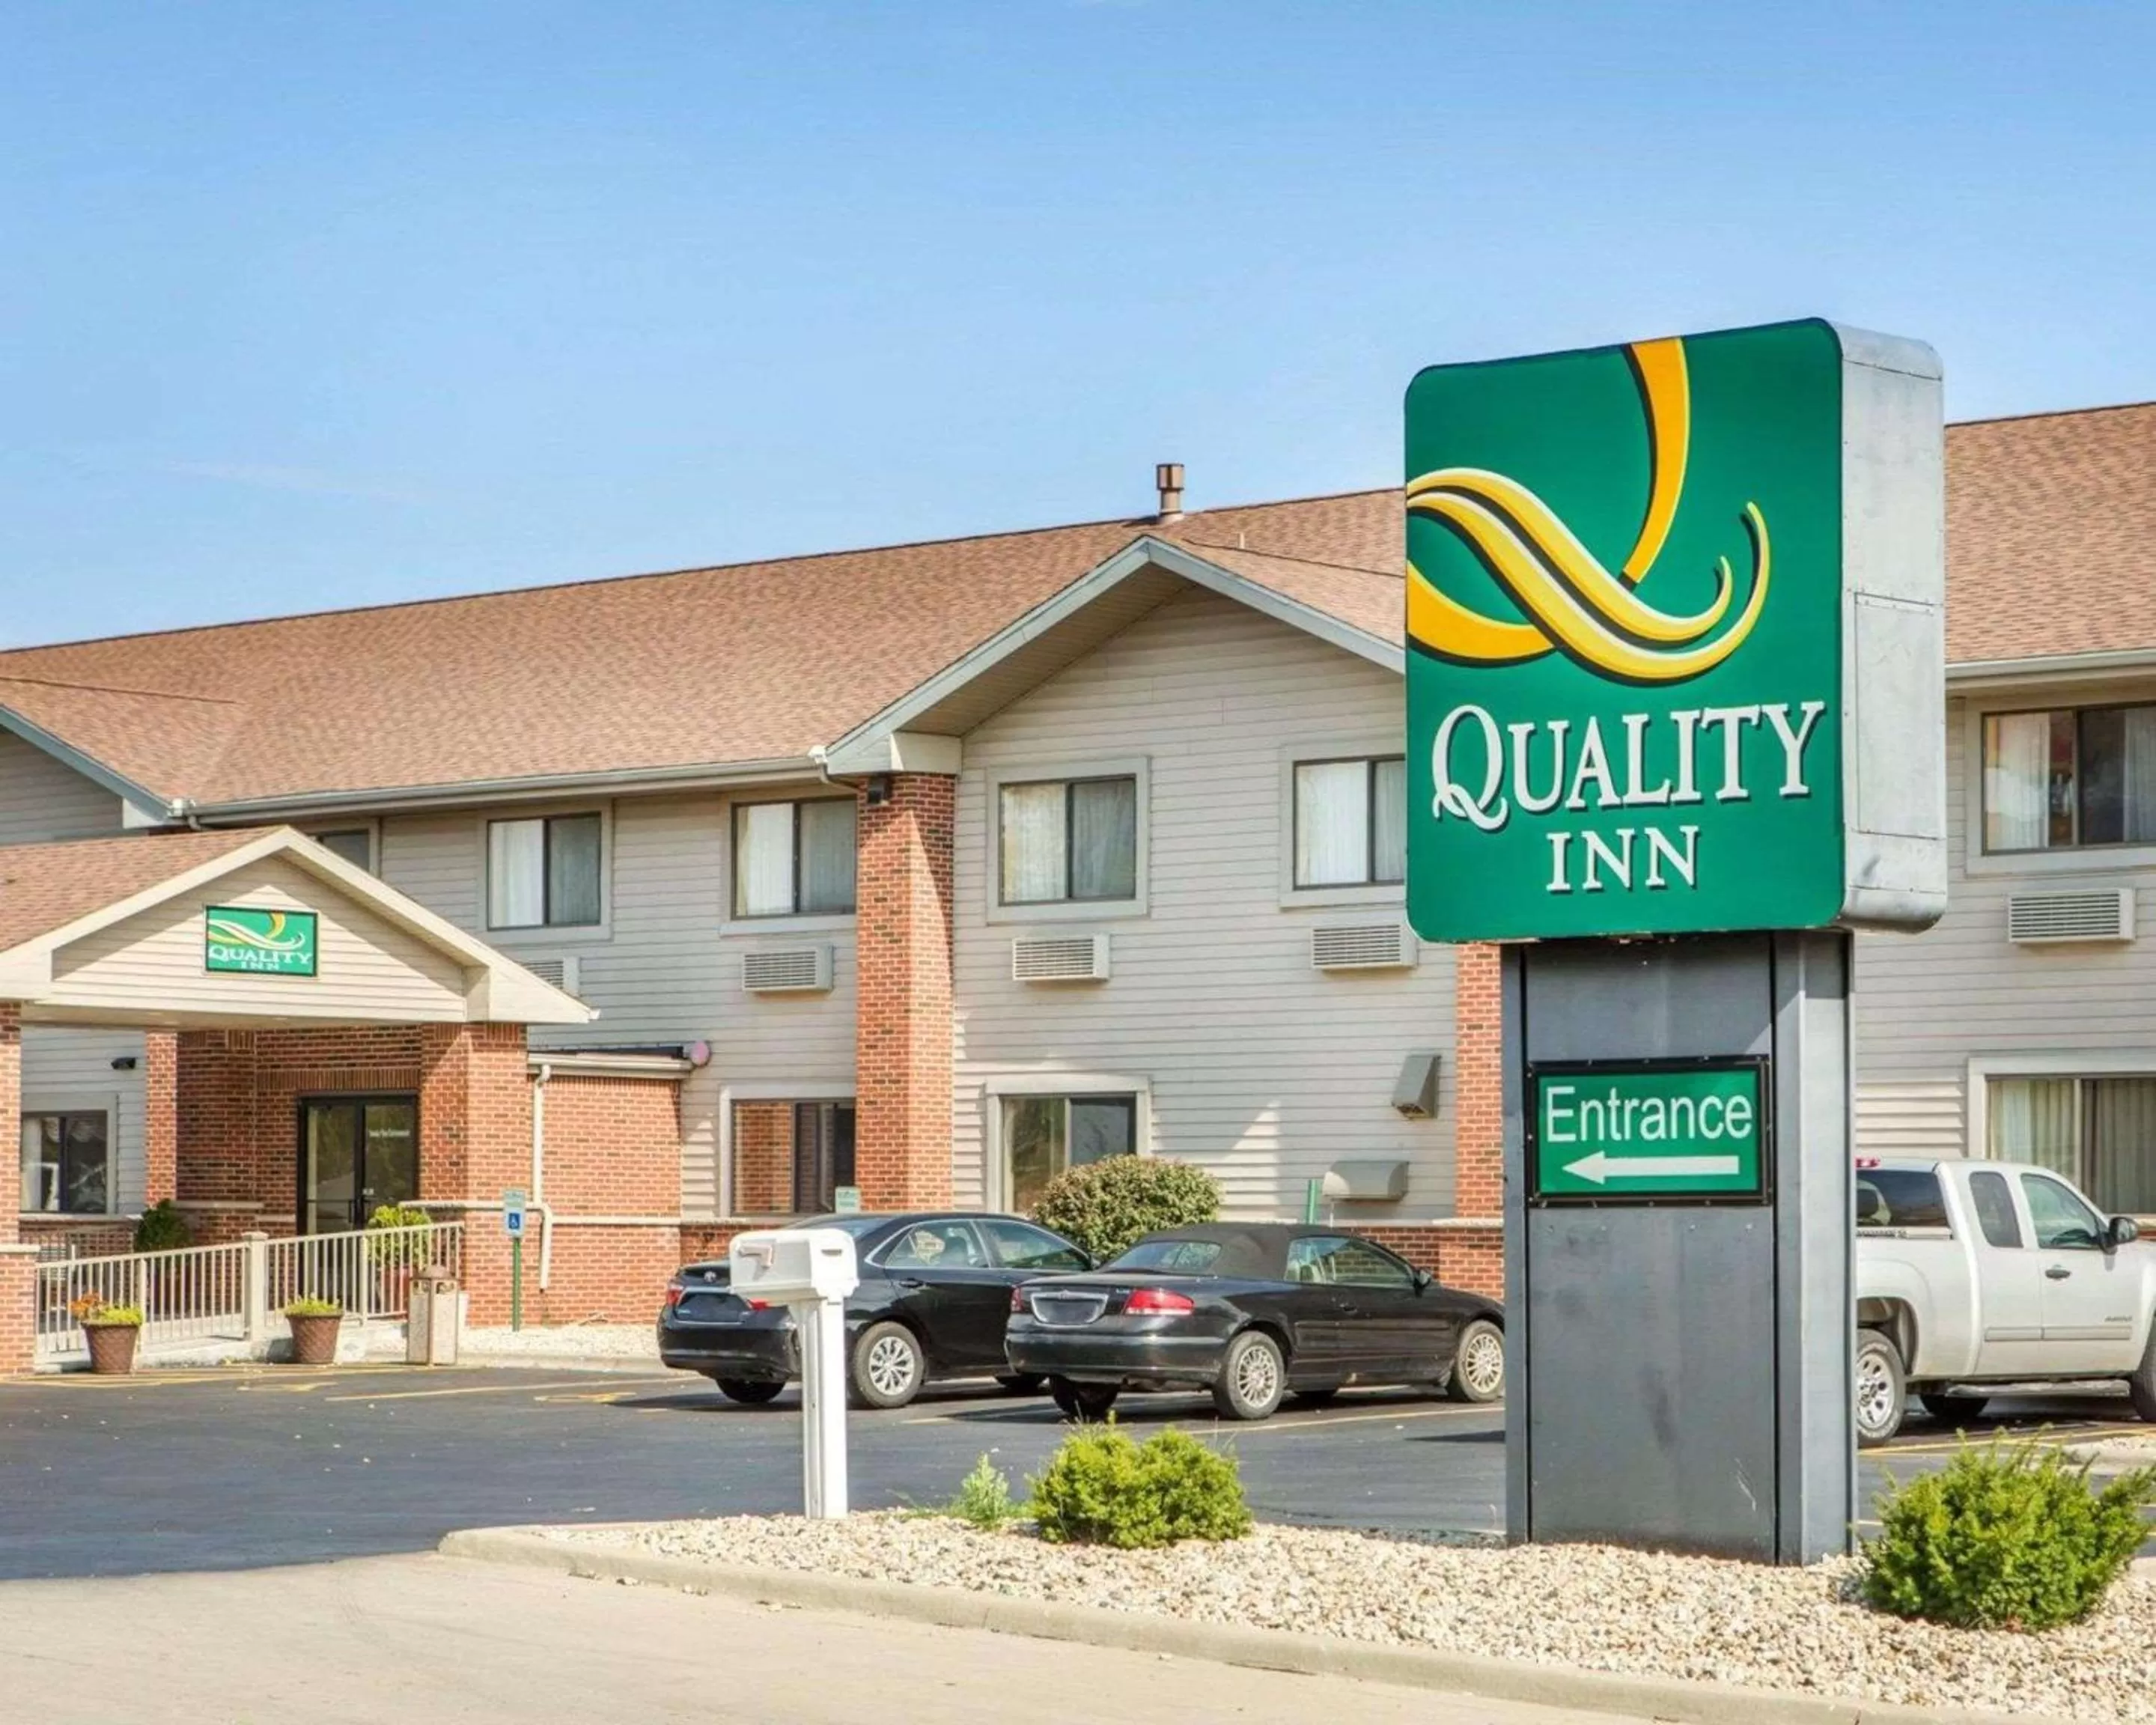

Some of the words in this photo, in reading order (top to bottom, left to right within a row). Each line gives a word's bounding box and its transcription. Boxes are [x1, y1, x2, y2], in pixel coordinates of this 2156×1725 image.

[1431, 701, 1825, 831] QUALITY
[1546, 825, 1699, 892] INN
[208, 945, 312, 964] QUALITY
[1546, 1086, 1753, 1143] Entrance
